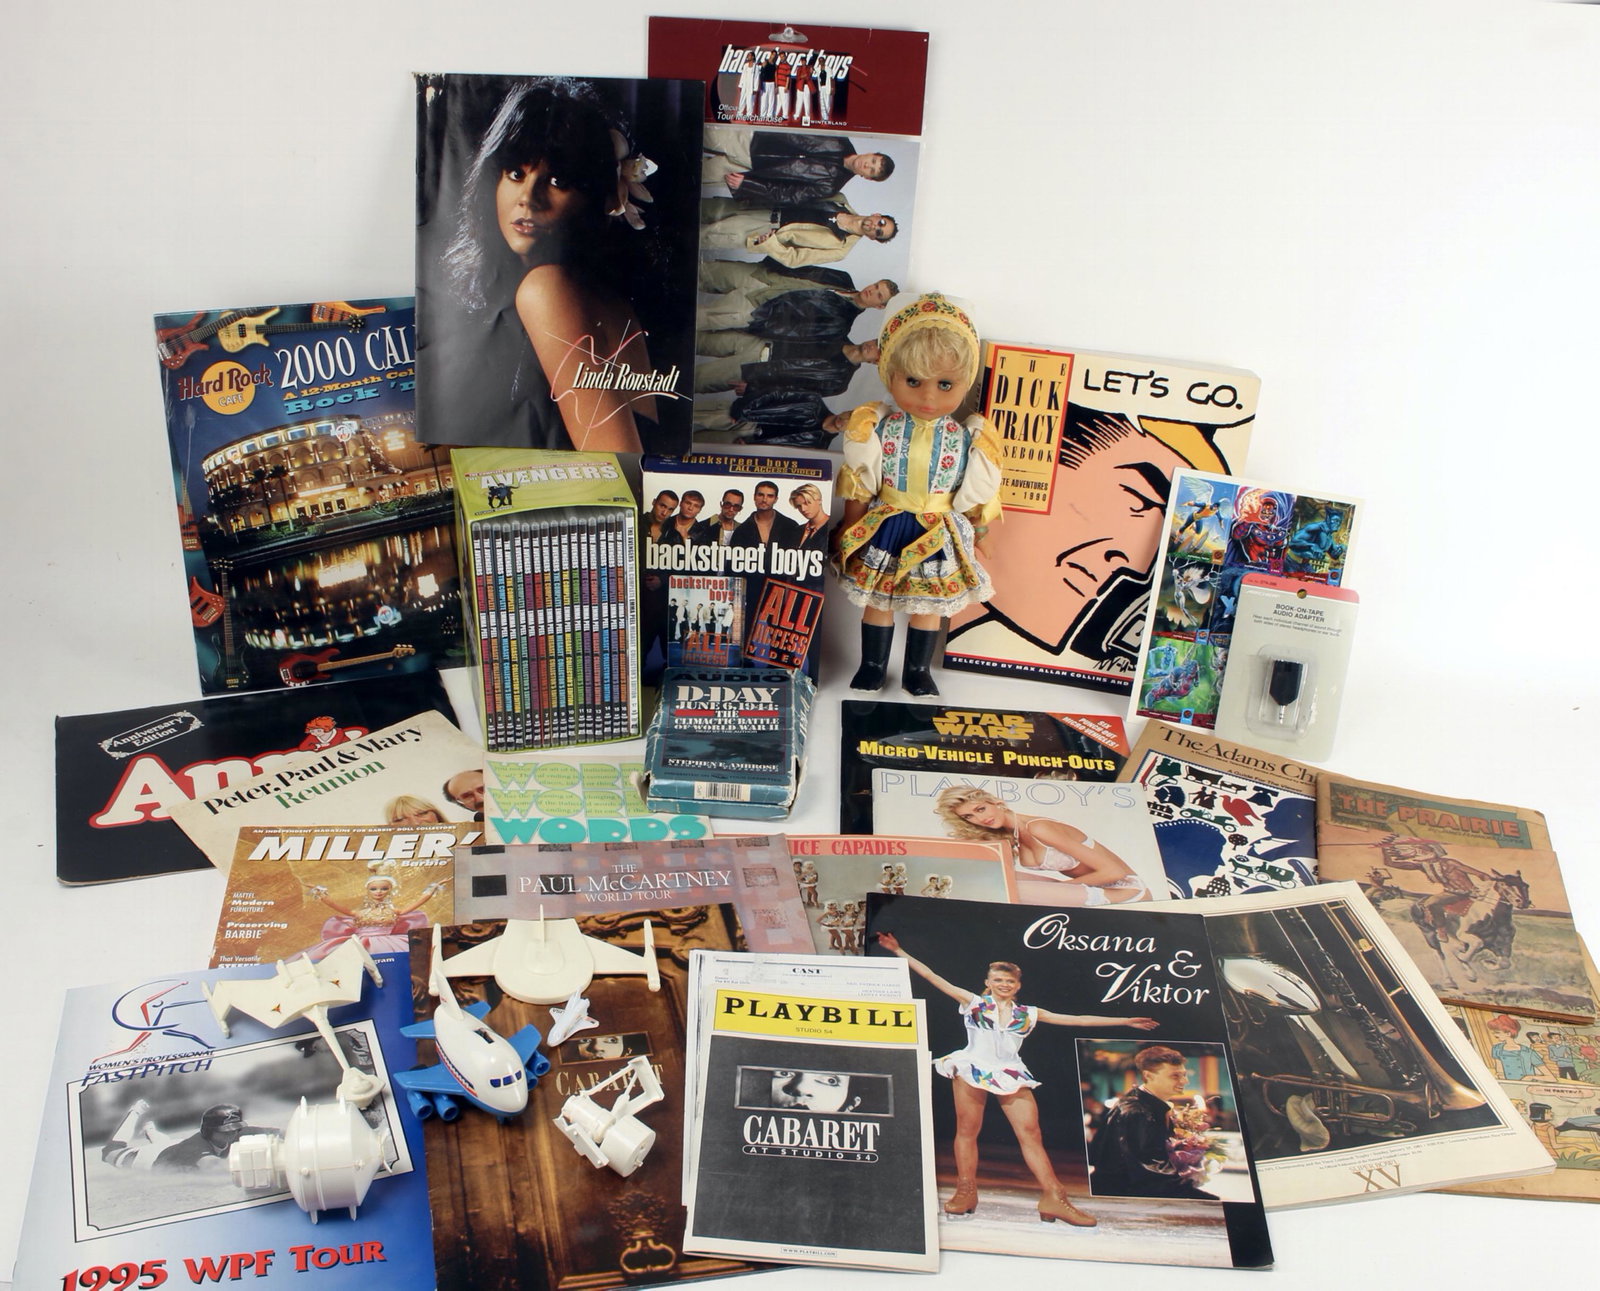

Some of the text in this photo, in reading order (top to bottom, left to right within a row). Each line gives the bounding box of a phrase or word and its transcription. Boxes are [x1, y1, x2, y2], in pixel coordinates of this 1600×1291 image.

[717, 111, 783, 123] Tour Merchandise
[274, 325, 416, 390] 2000 CAL
[1000, 356, 1066, 376] THE
[178, 363, 275, 401] Hard Rock
[282, 392, 298, 401] A
[301, 374, 383, 397] 12-Month
[572, 362, 681, 392] Linda Ronstadt
[995, 374, 1061, 411] DICK
[1083, 368, 1243, 410] LET'S GO.
[218, 393, 244, 408] CAFE
[283, 386, 380, 415] Rock
[991, 409, 1059, 445] TRACY
[682, 455, 758, 466] backstreet
[766, 458, 798, 468] boys
[1002, 445, 1053, 463] SEBOOK
[481, 465, 620, 489] AVENGERS
[1011, 478, 1049, 491] ADVENTURES
[646, 537, 824, 581] backstreet boys
[669, 576, 735, 603] backstreet boys
[759, 585, 814, 634] ALL
[1273, 610, 1325, 623] AUDIO ADAPTER
[687, 632, 725, 653] ALL
[753, 622, 808, 655] ACCESS
[684, 653, 727, 665] ACCESS
[750, 645, 802, 665] VIDEO
[668, 674, 790, 683] AUDIO
[952, 657, 998, 668] SELECTED
[1016, 664, 1035, 672] MAX
[1038, 667, 1068, 677] ALLAN
[1070, 672, 1108, 683] COLLINS
[676, 686, 780, 703] D-DAY
[676, 701, 720, 710] JUNE
[674, 717, 736, 725] CLIMACTIC
[715, 710, 740, 718] THE
[932, 711, 1034, 728] STAR
[1097, 720, 1112, 729] SIX
[113, 717, 183, 747] Anniversary
[132, 727, 177, 747] Edition
[933, 722, 1035, 740] WARS
[941, 737, 1018, 748] EPISODE
[1160, 726, 1203, 751] The
[1205, 743, 1276, 772] Adams
[203, 725, 423, 815] Peter, Paul & Mary
[668, 758, 718, 768] STEPHEN
[730, 762, 779, 772] AMBROSE
[1233, 771, 1253, 779] Guide
[274, 761, 387, 808] Reunion
[880, 771, 1136, 809] PLAYBOY'S
[1336, 793, 1388, 817] THE
[1398, 806, 1521, 837] PRAIRIE
[491, 815, 707, 844] WORDS
[791, 840, 908, 856] ICE CAPADES
[611, 864, 638, 873] THE
[519, 870, 733, 894] PAUL McCARTNEY
[585, 890, 673, 903] WORLD TOUR
[224, 929, 263, 939] BARBIE
[226, 921, 288, 930] Preserving
[1023, 913, 1156, 953] Oksana
[792, 967, 823, 975] CAST
[1167, 950, 1202, 979] &
[1095, 962, 1209, 1005] Viktor
[722, 996, 913, 1028] PLAYBILL
[88, 1050, 215, 1071] WOMEN'S PROFESSIONAL
[81, 1059, 212, 1086] FASTPITCH
[743, 1115, 881, 1152] CABARET
[750, 1147, 768, 1155] AT
[781, 1149, 844, 1160] STUDIO
[1353, 1164, 1401, 1194] XV
[60, 1240, 387, 1291] 1995 WPF TOUR
